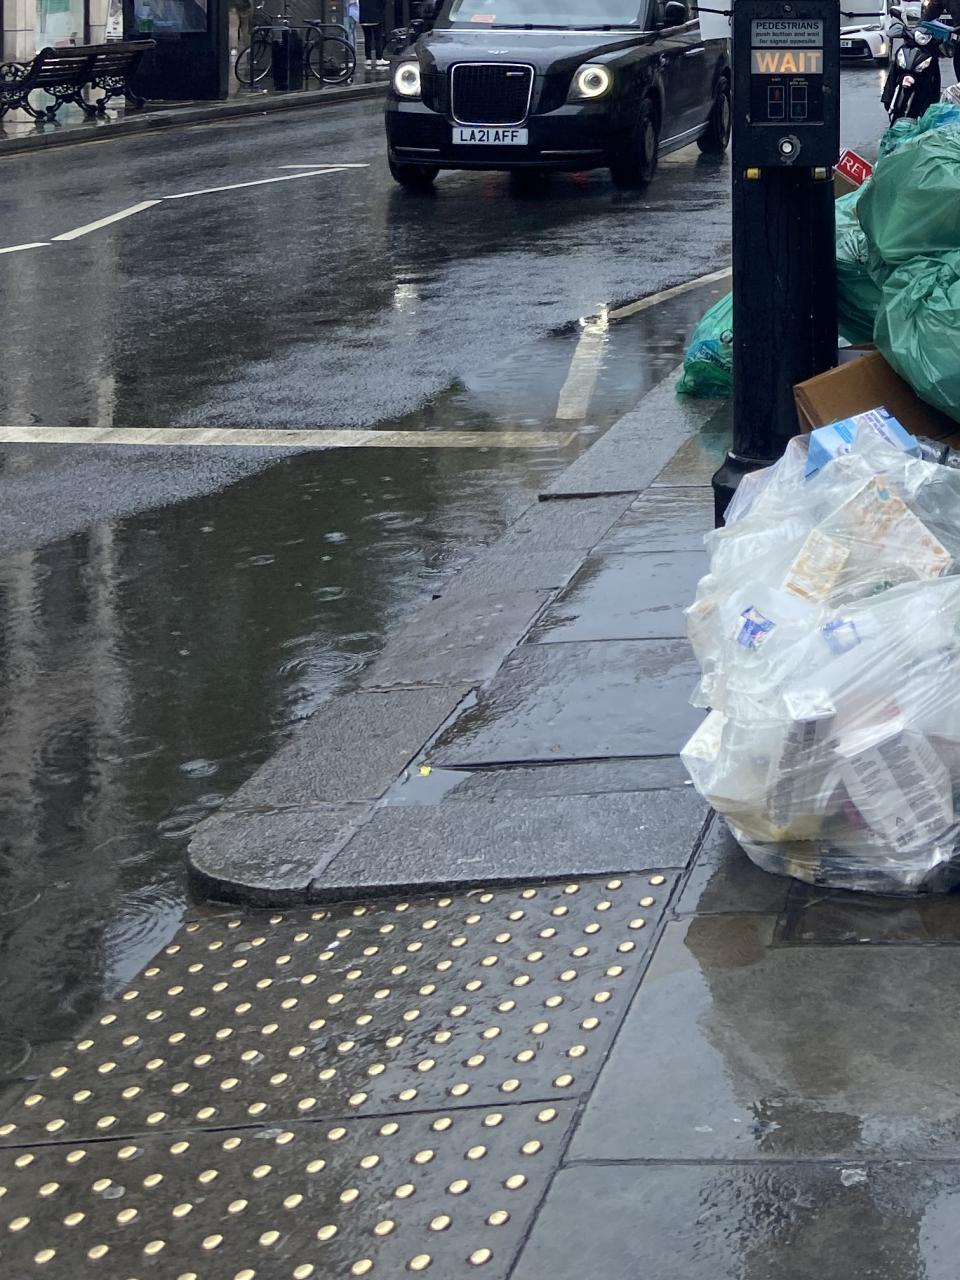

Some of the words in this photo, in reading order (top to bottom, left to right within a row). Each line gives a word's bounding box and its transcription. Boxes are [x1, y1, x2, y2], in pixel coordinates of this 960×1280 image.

[756, 22, 820, 30] PEDESTRIANS
[755, 52, 820, 73] WAIT
[460, 129, 490, 142] LA21
[494, 130, 519, 143] AFF
